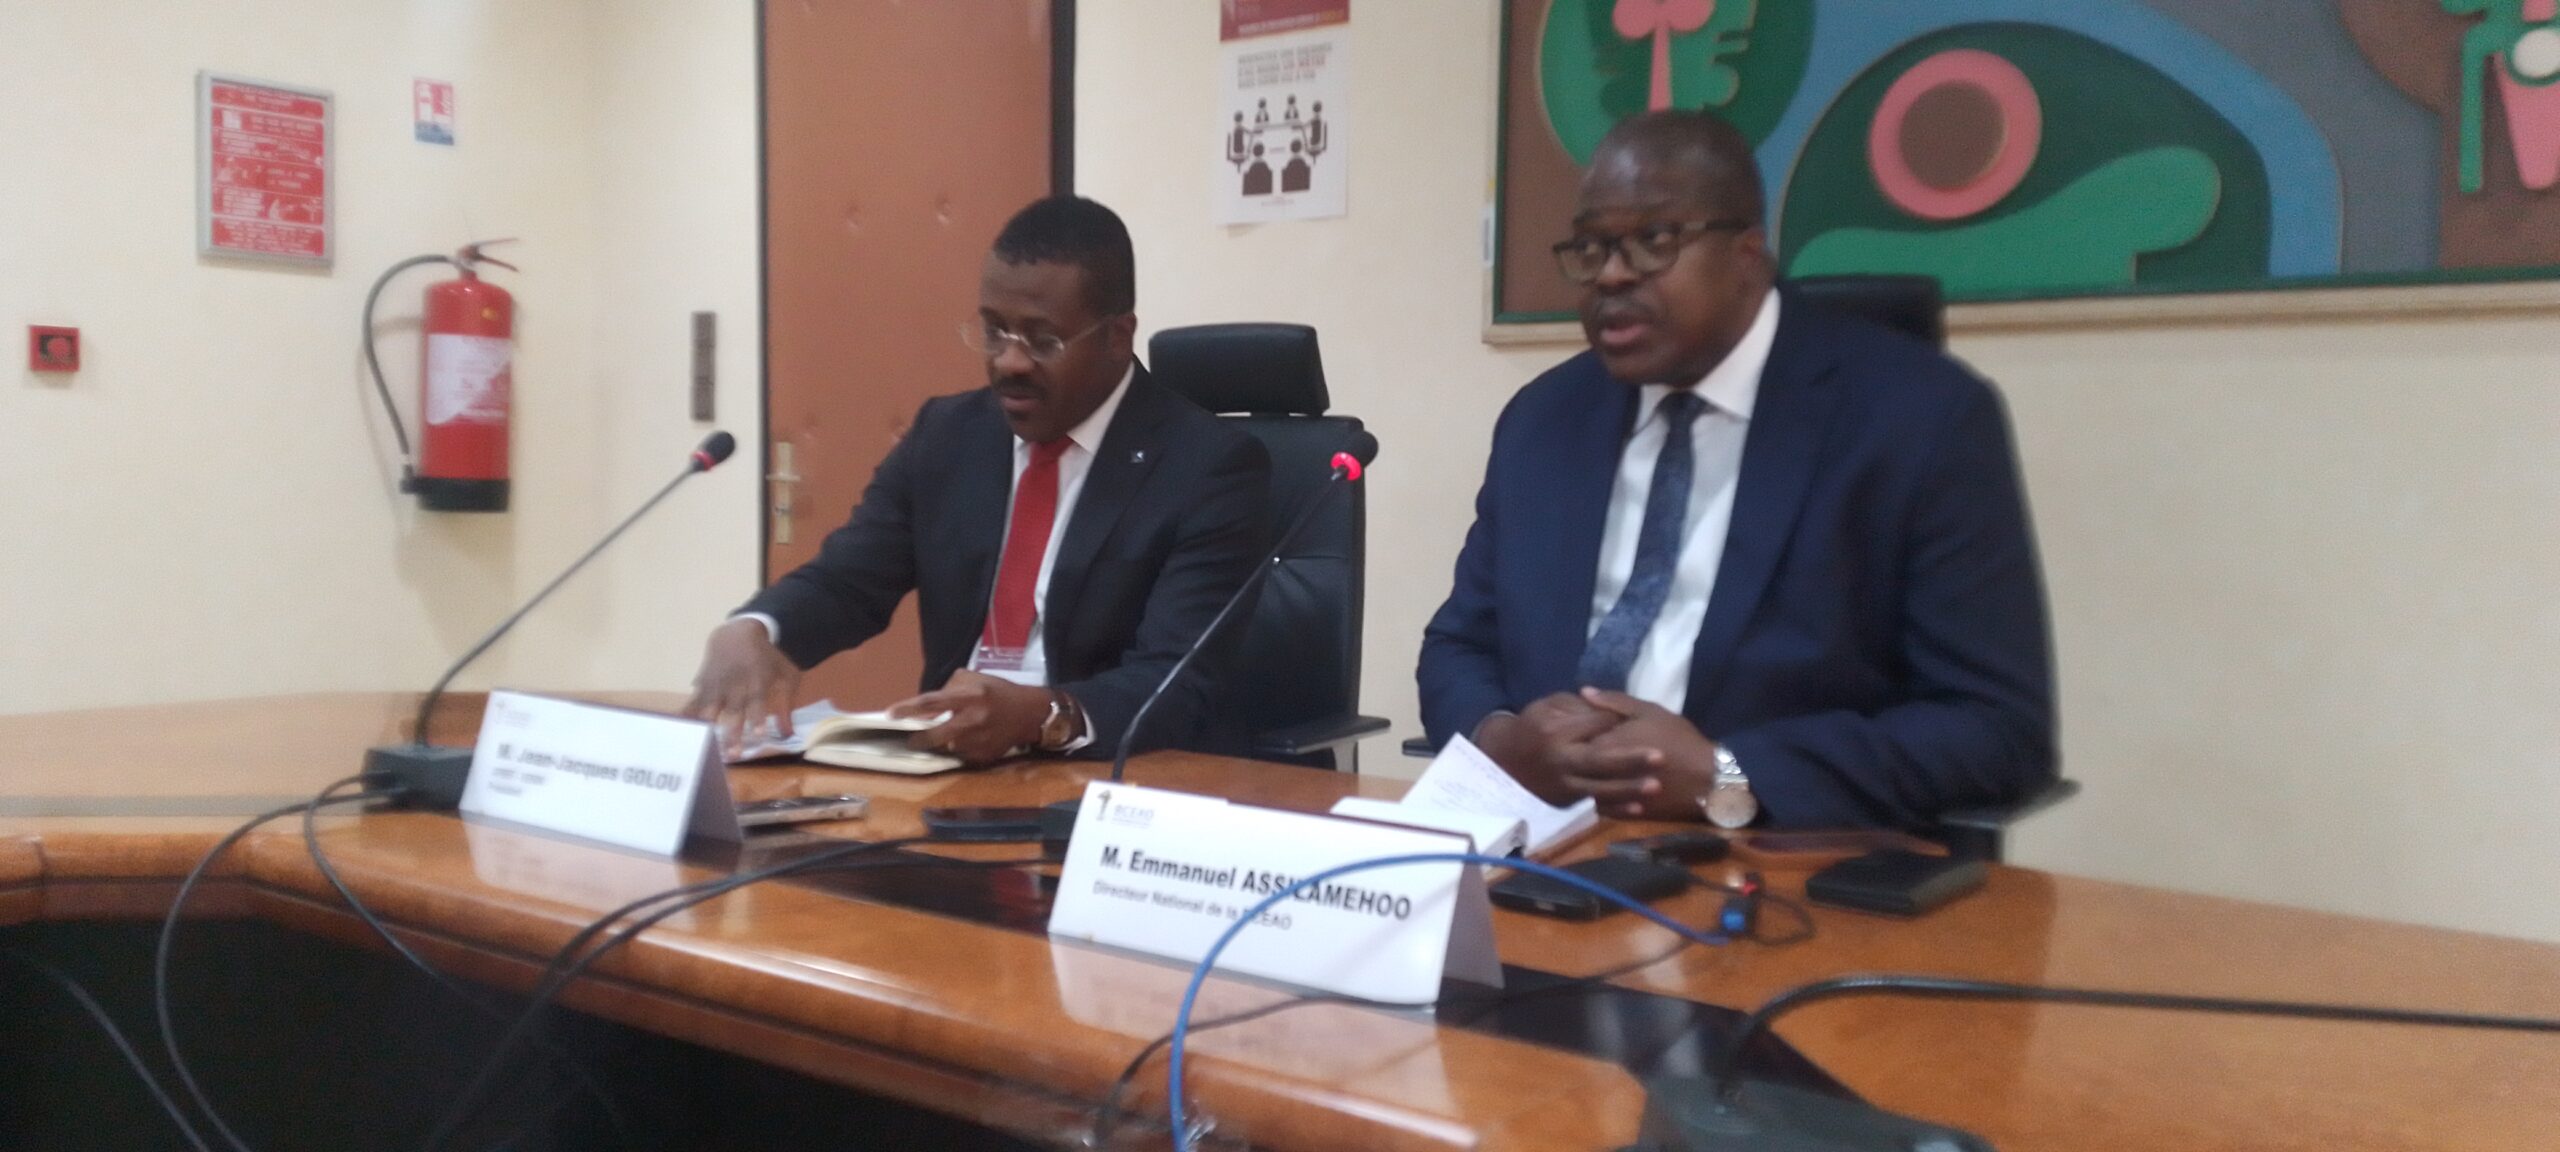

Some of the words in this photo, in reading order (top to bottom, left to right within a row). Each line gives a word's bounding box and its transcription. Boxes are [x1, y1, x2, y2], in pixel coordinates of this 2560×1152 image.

[518, 748, 618, 780] Jean-Jacques
[622, 766, 683, 793] GOLOU
[1100, 845, 1122, 869] M.
[1129, 850, 1237, 891] Emmanuel
[1093, 879, 1148, 902] Directeur
[1152, 890, 1204, 915] National
[1206, 901, 1223, 918] de
[1225, 905, 1238, 921] la
[1244, 907, 1292, 930] EAO
